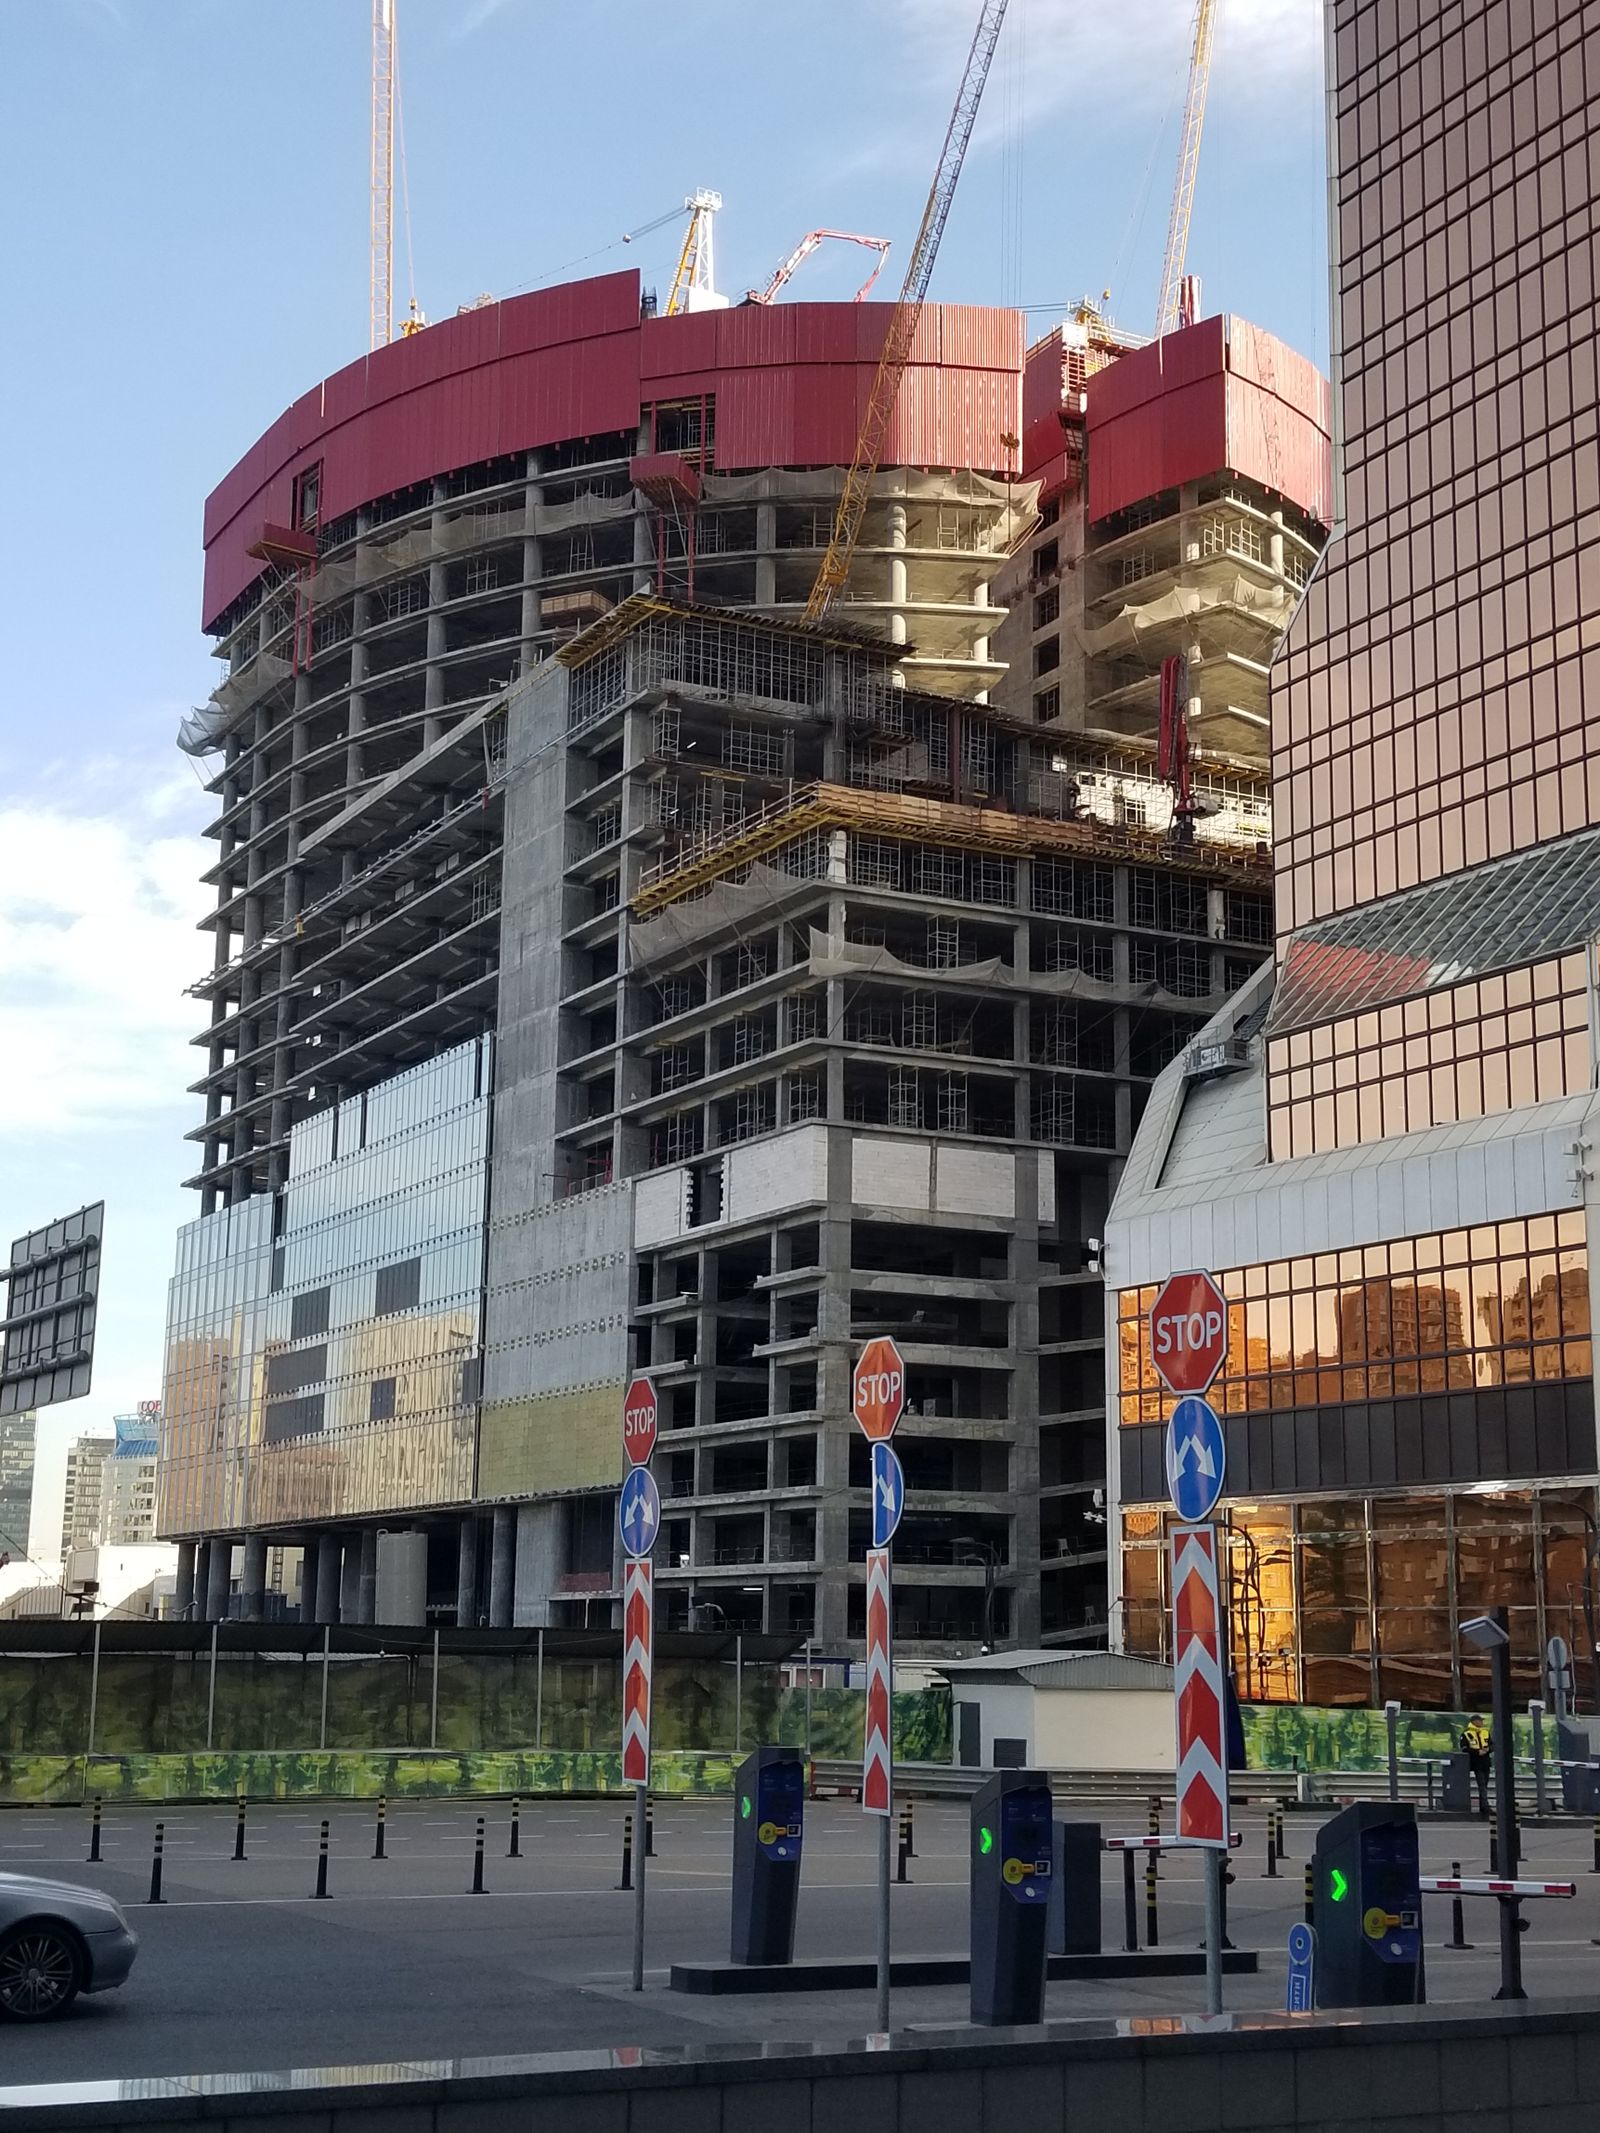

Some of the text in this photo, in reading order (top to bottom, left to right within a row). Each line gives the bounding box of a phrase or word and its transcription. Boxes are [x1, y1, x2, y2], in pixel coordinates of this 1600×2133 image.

[1156, 1310, 1221, 1353] STOP
[857, 1371, 900, 1407] STOP
[625, 1406, 655, 1436] STOP
